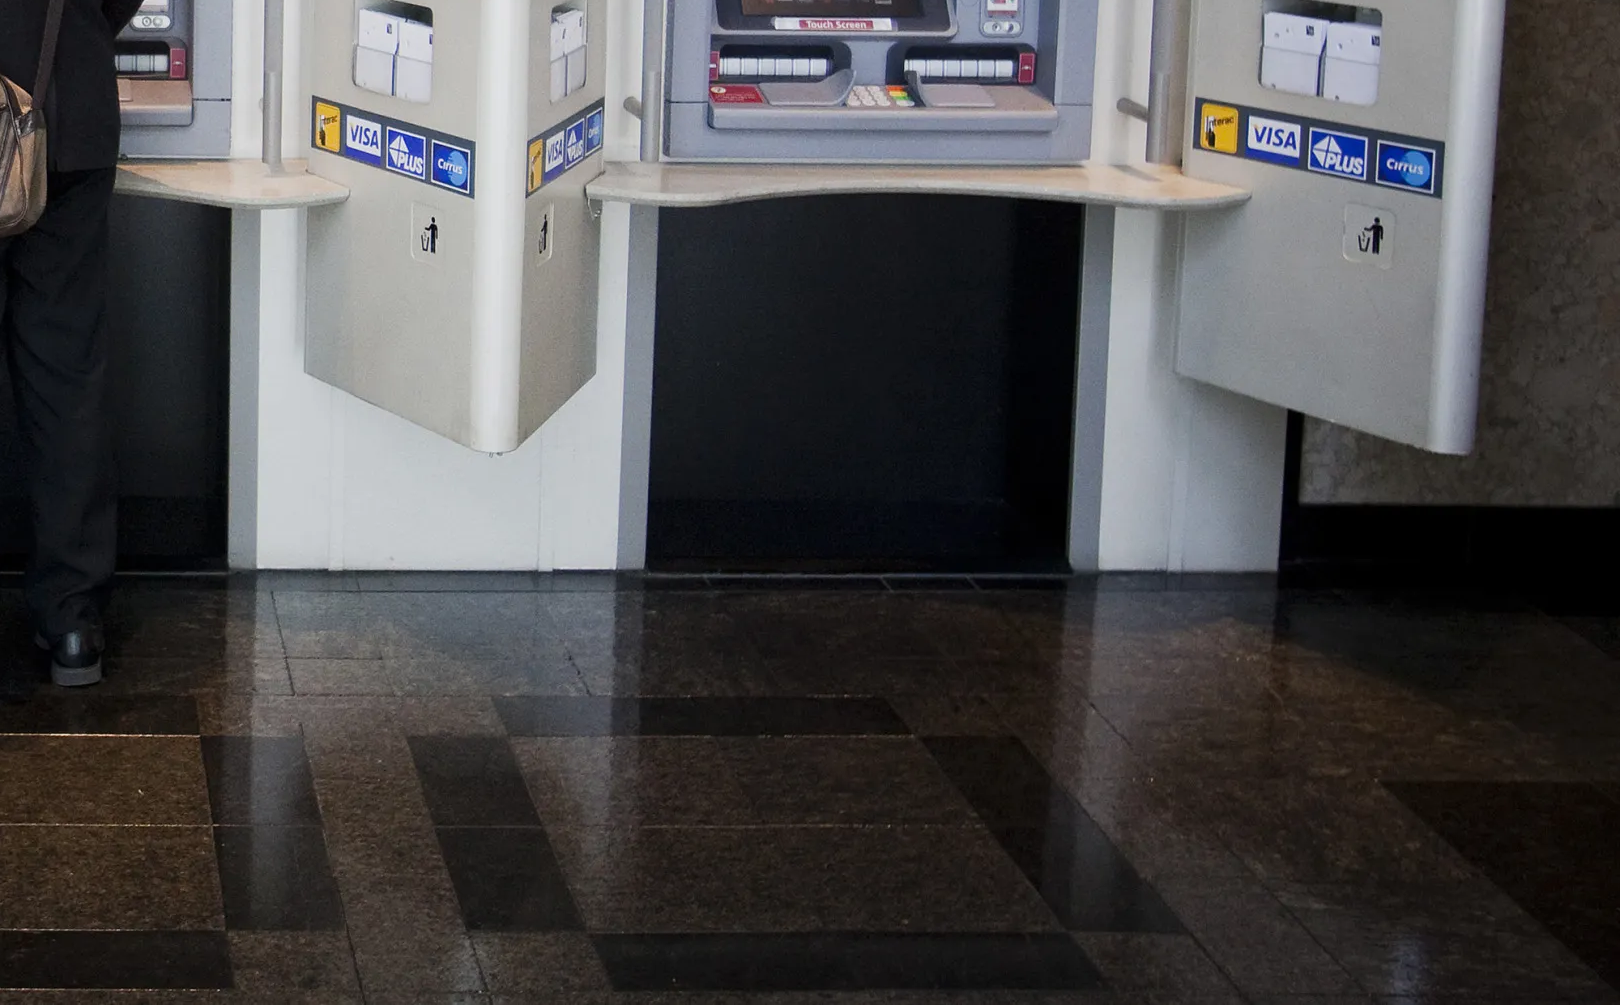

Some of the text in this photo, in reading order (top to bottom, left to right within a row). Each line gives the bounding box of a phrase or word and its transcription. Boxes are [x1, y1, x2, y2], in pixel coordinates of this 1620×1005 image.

[805, 20, 867, 29] Touch Screen
[350, 125, 379, 150] VISA
[397, 152, 423, 174] PLUS
[438, 158, 463, 175] Cirrus
[547, 139, 563, 164] VISA
[1254, 125, 1297, 150] VISA
[1325, 152, 1363, 174] PLUS
[1386, 158, 1424, 175] Cirrus
